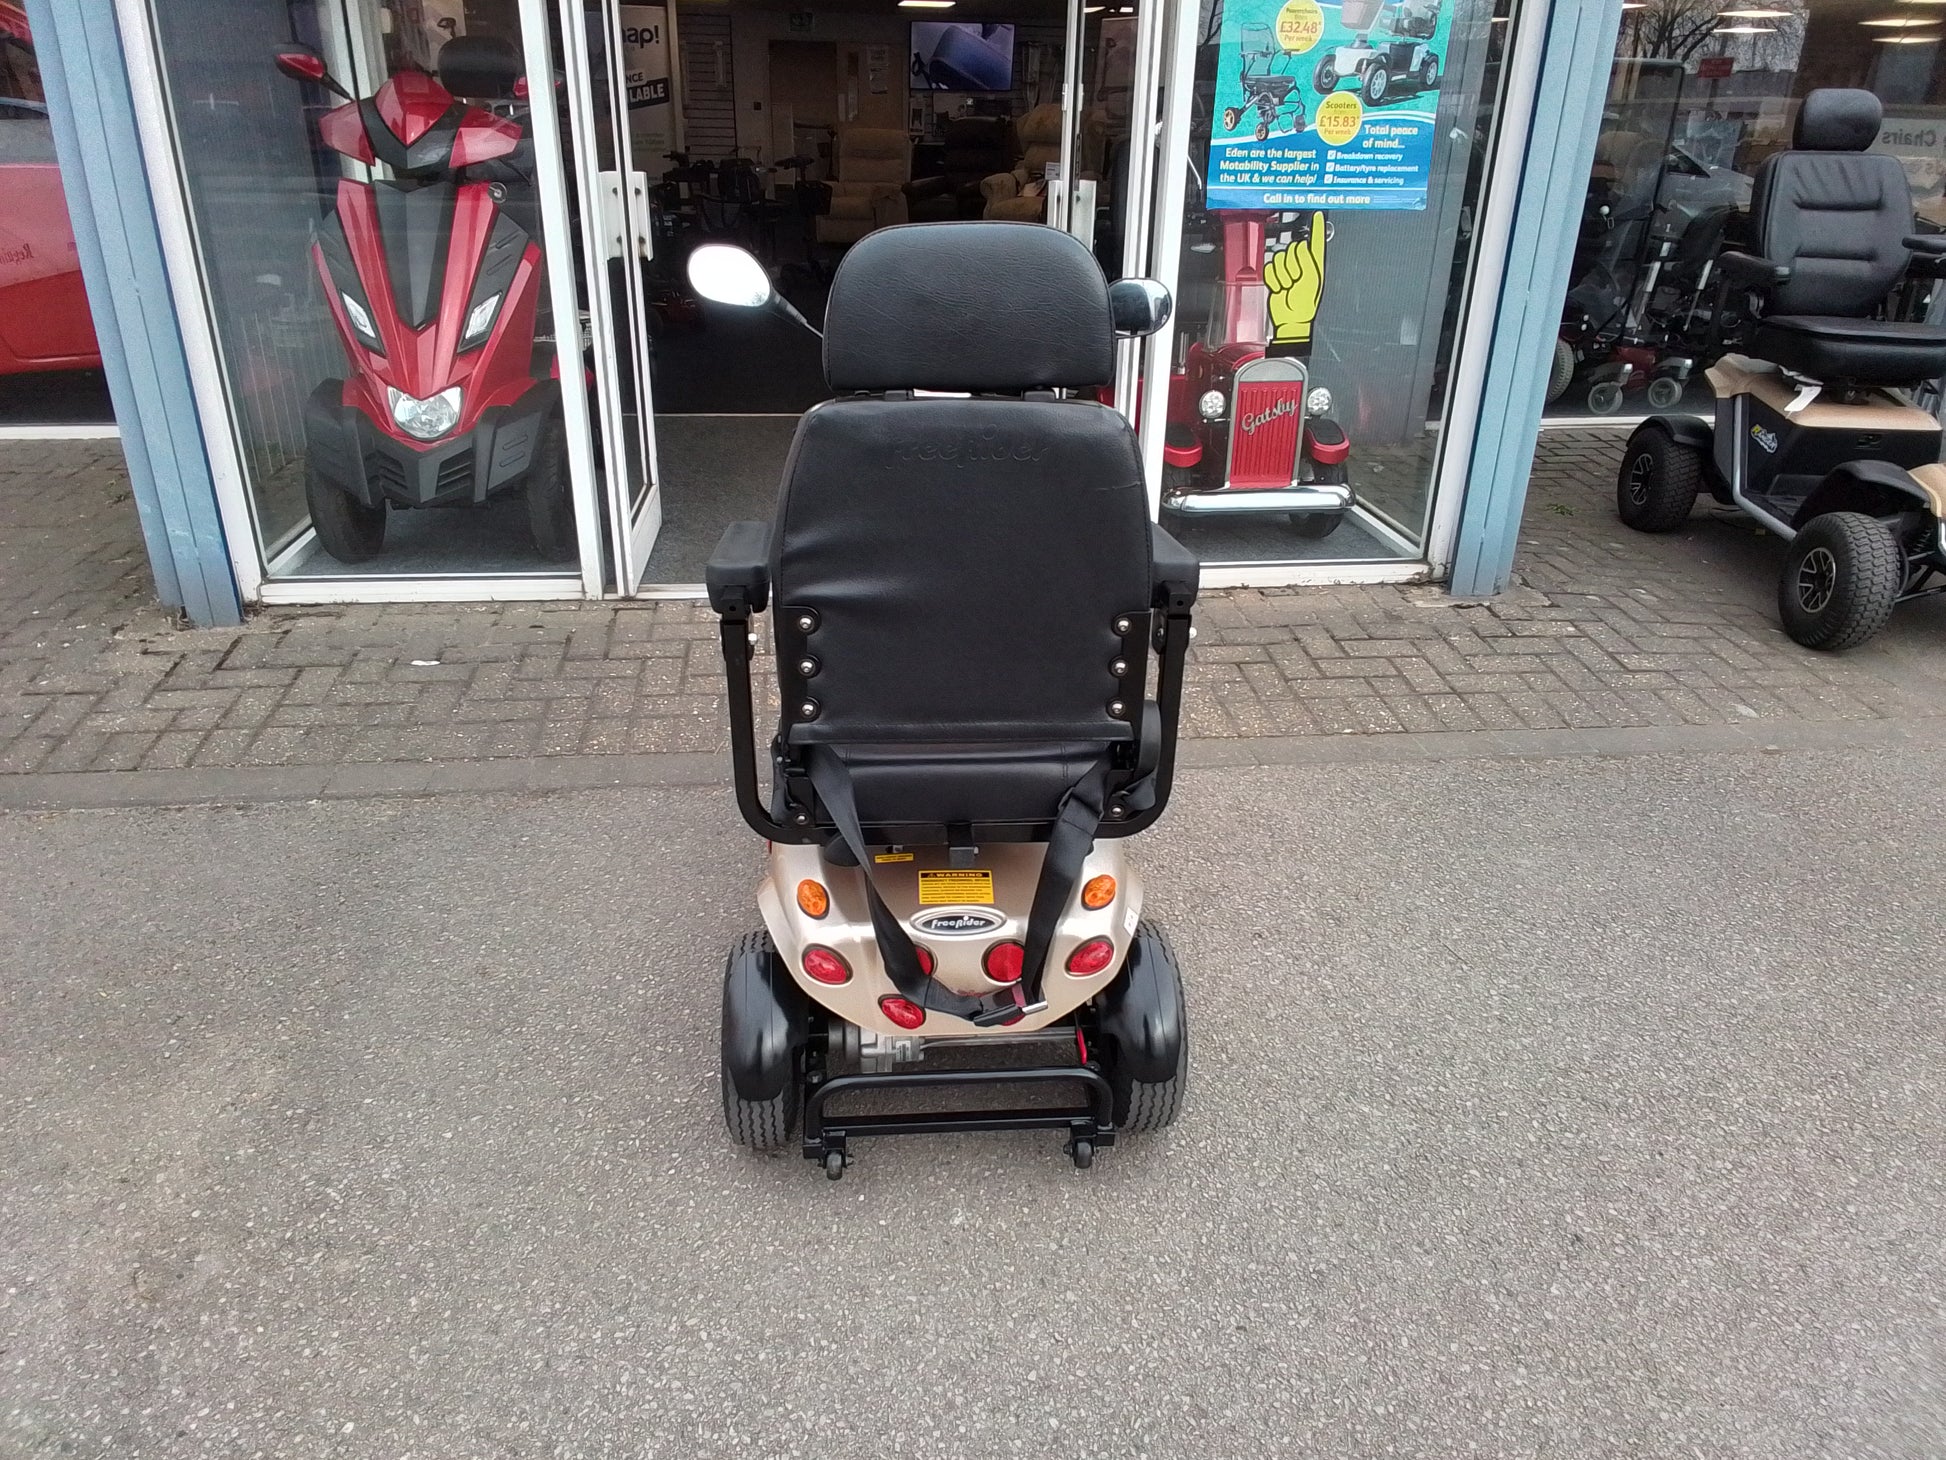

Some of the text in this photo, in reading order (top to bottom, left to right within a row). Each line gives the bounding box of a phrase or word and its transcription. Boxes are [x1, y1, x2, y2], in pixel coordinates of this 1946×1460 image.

[1326, 101, 1357, 109] Scooters
[1364, 124, 1418, 137] Total peace
[1363, 138, 1373, 148] of
[1225, 147, 1316, 161] Eden are the largest
[1220, 160, 1319, 173] Motability Supplier in
[1220, 173, 1317, 185] the UK & we can help!
[1263, 193, 1281, 203] Call
[1283, 194, 1292, 203] in
[1294, 194, 1305, 203] to
[1307, 193, 1326, 203] find
[1327, 194, 1344, 204] out
[1346, 196, 1370, 204] more
[1241, 396, 1299, 435] Gatsby
